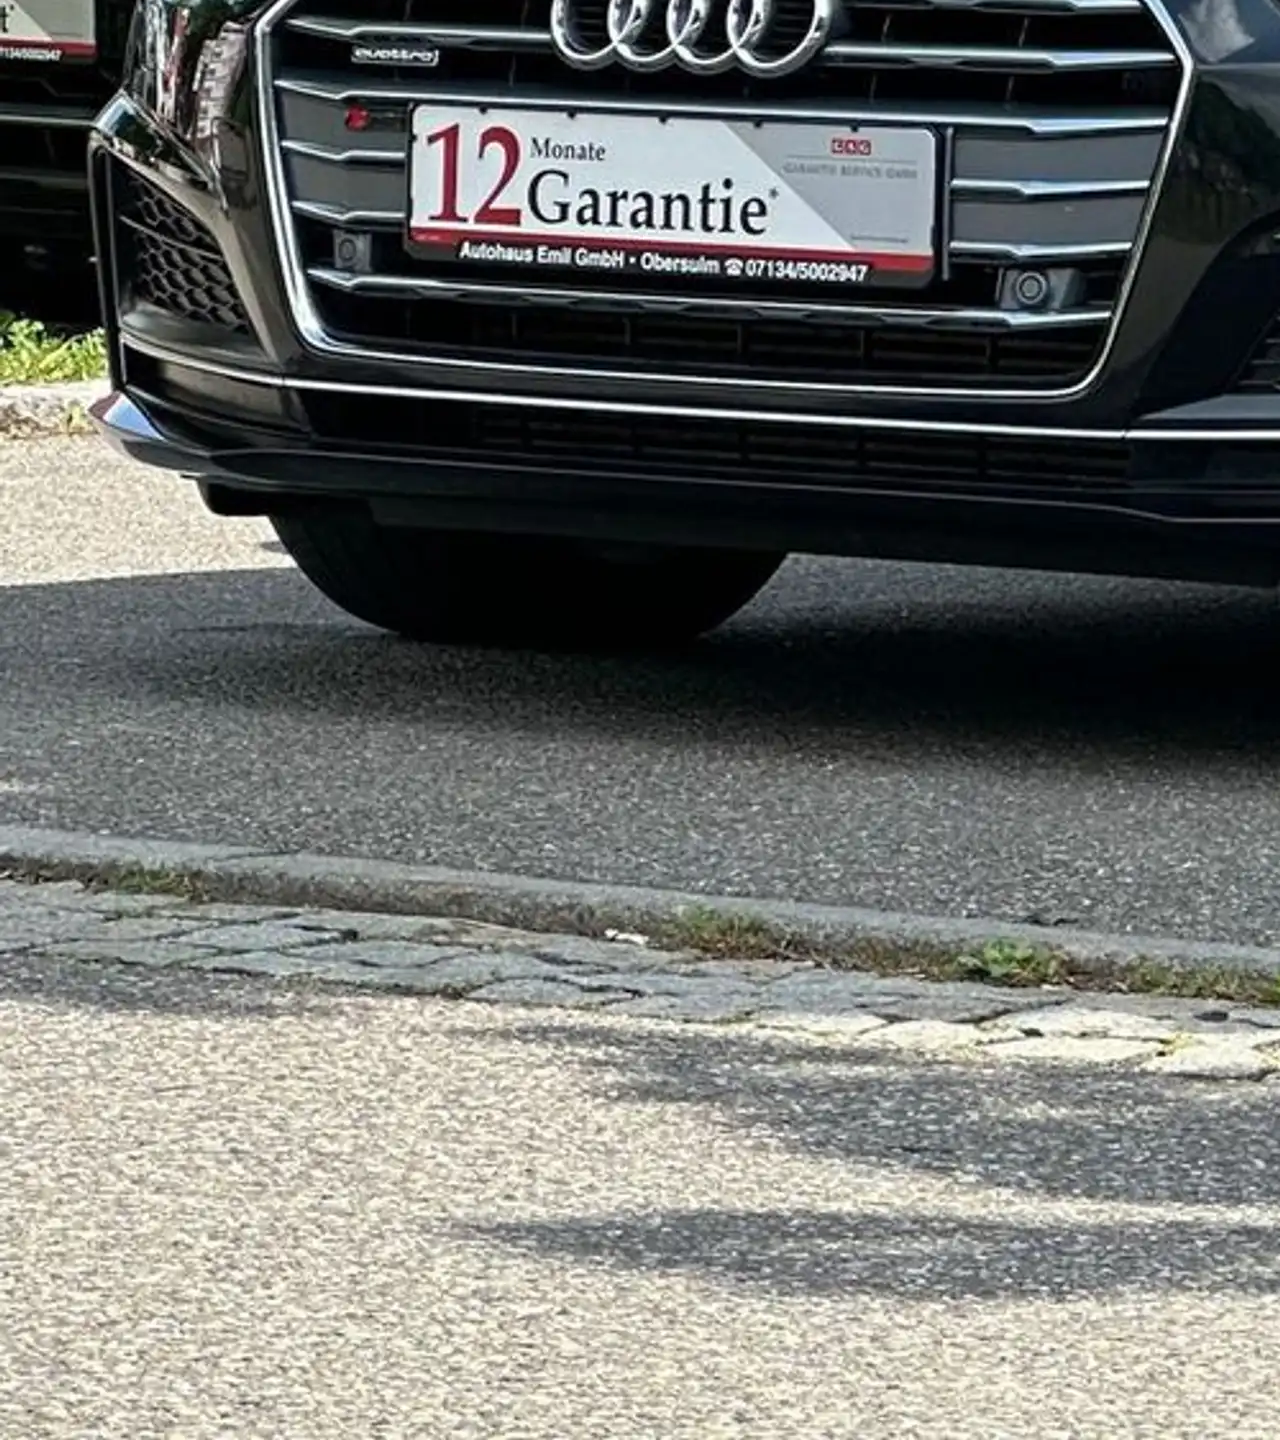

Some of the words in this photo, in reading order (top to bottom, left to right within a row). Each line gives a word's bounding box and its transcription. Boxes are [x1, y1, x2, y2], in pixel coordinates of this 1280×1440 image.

[529, 137, 606, 161] Monate
[426, 123, 522, 227] 12
[459, 242, 534, 263] Autohaus
[538, 245, 571, 264] Emil
[575, 247, 624, 269] GmbH
[640, 252, 720, 275] Obersulm
[745, 258, 868, 282] 07134/5002947
